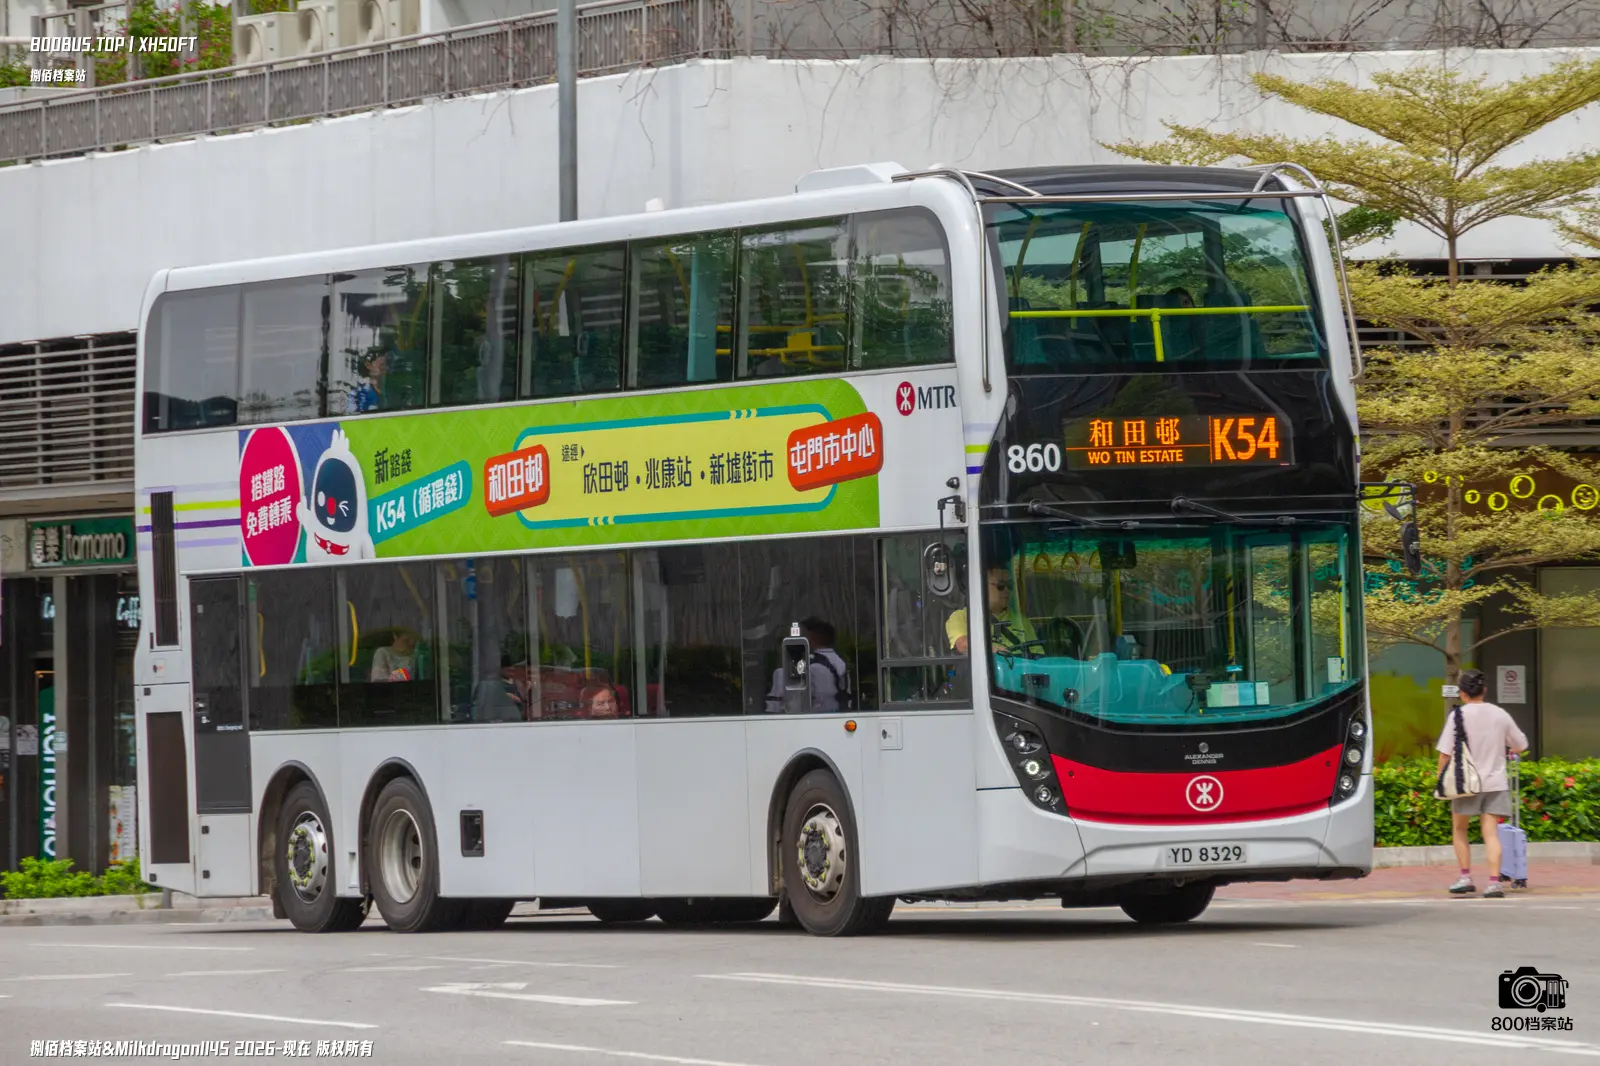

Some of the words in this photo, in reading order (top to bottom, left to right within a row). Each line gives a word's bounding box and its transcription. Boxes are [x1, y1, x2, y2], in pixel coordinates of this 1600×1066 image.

[918, 384, 957, 410] MTR
[790, 423, 876, 475] 屯門市中心
[1089, 417, 1180, 447] 和田邨
[1212, 416, 1280, 461] K54
[1007, 443, 1061, 474] 860
[1088, 451, 1111, 464] WO
[1114, 450, 1136, 464] TIN
[1139, 449, 1184, 463] ESTATE
[250, 463, 286, 502] 搭鐵路
[488, 452, 543, 503] 和田邨
[246, 495, 292, 539] 免費轉乘
[1171, 847, 1193, 863] YD
[1199, 846, 1242, 862] 8329
